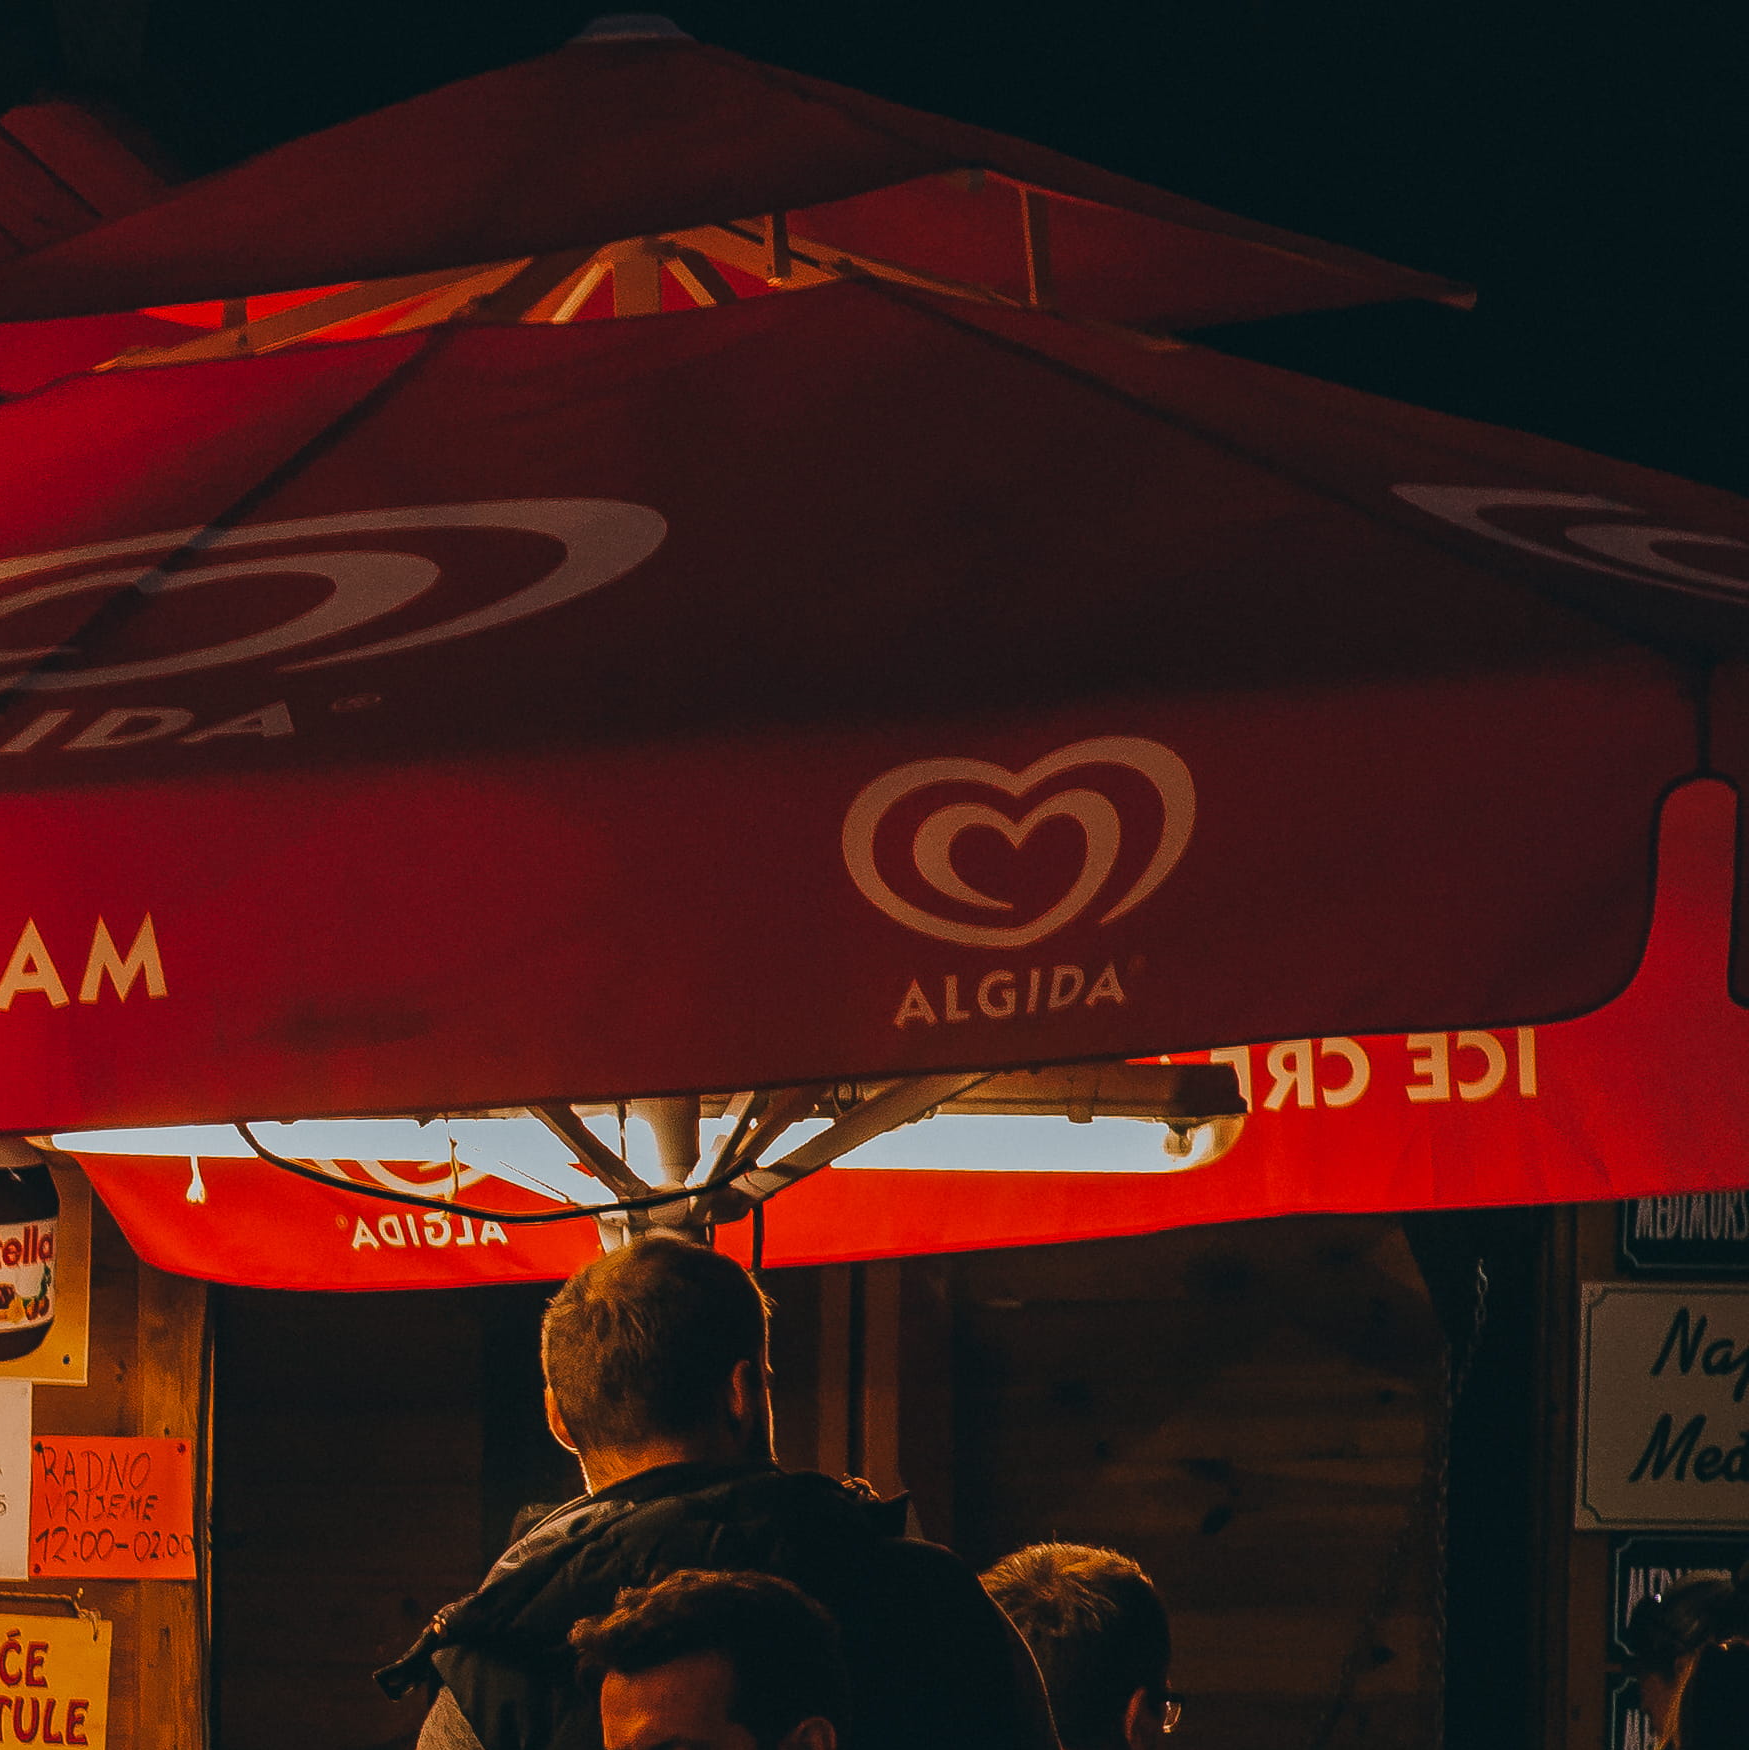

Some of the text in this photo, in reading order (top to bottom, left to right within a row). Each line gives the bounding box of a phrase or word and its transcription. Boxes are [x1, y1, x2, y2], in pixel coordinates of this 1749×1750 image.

[893, 962, 1127, 1030] ALGIDA
[42, 1447, 151, 1492] RADNO
[45, 1490, 159, 1523] VRIJEME
